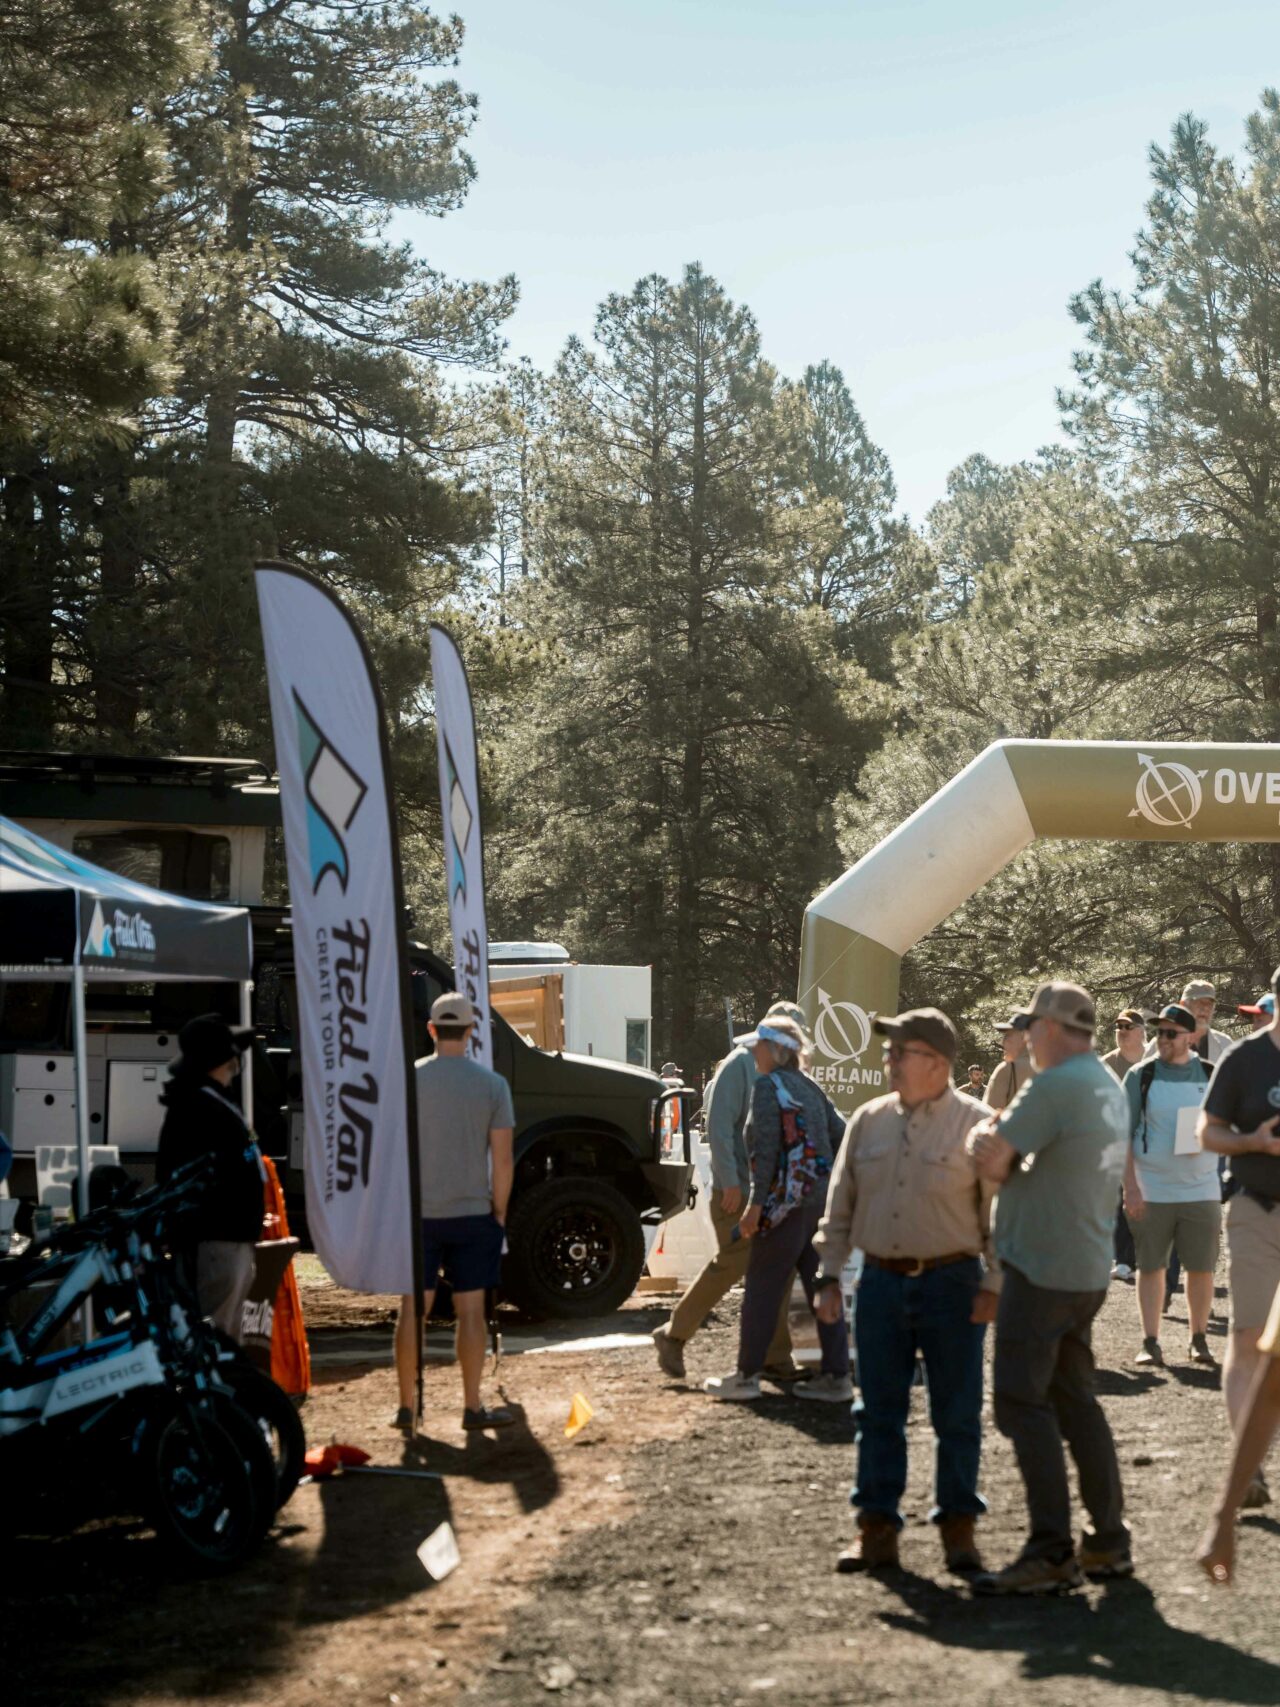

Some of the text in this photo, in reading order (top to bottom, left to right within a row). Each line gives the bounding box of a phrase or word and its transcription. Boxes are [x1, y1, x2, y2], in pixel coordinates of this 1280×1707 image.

[113, 908, 139, 947] Field
[315, 926, 337, 1205] CREATE YOUR ADVENTURE
[331, 917, 380, 1194] Field Van
[56, 1361, 147, 1400] LECTRIC
